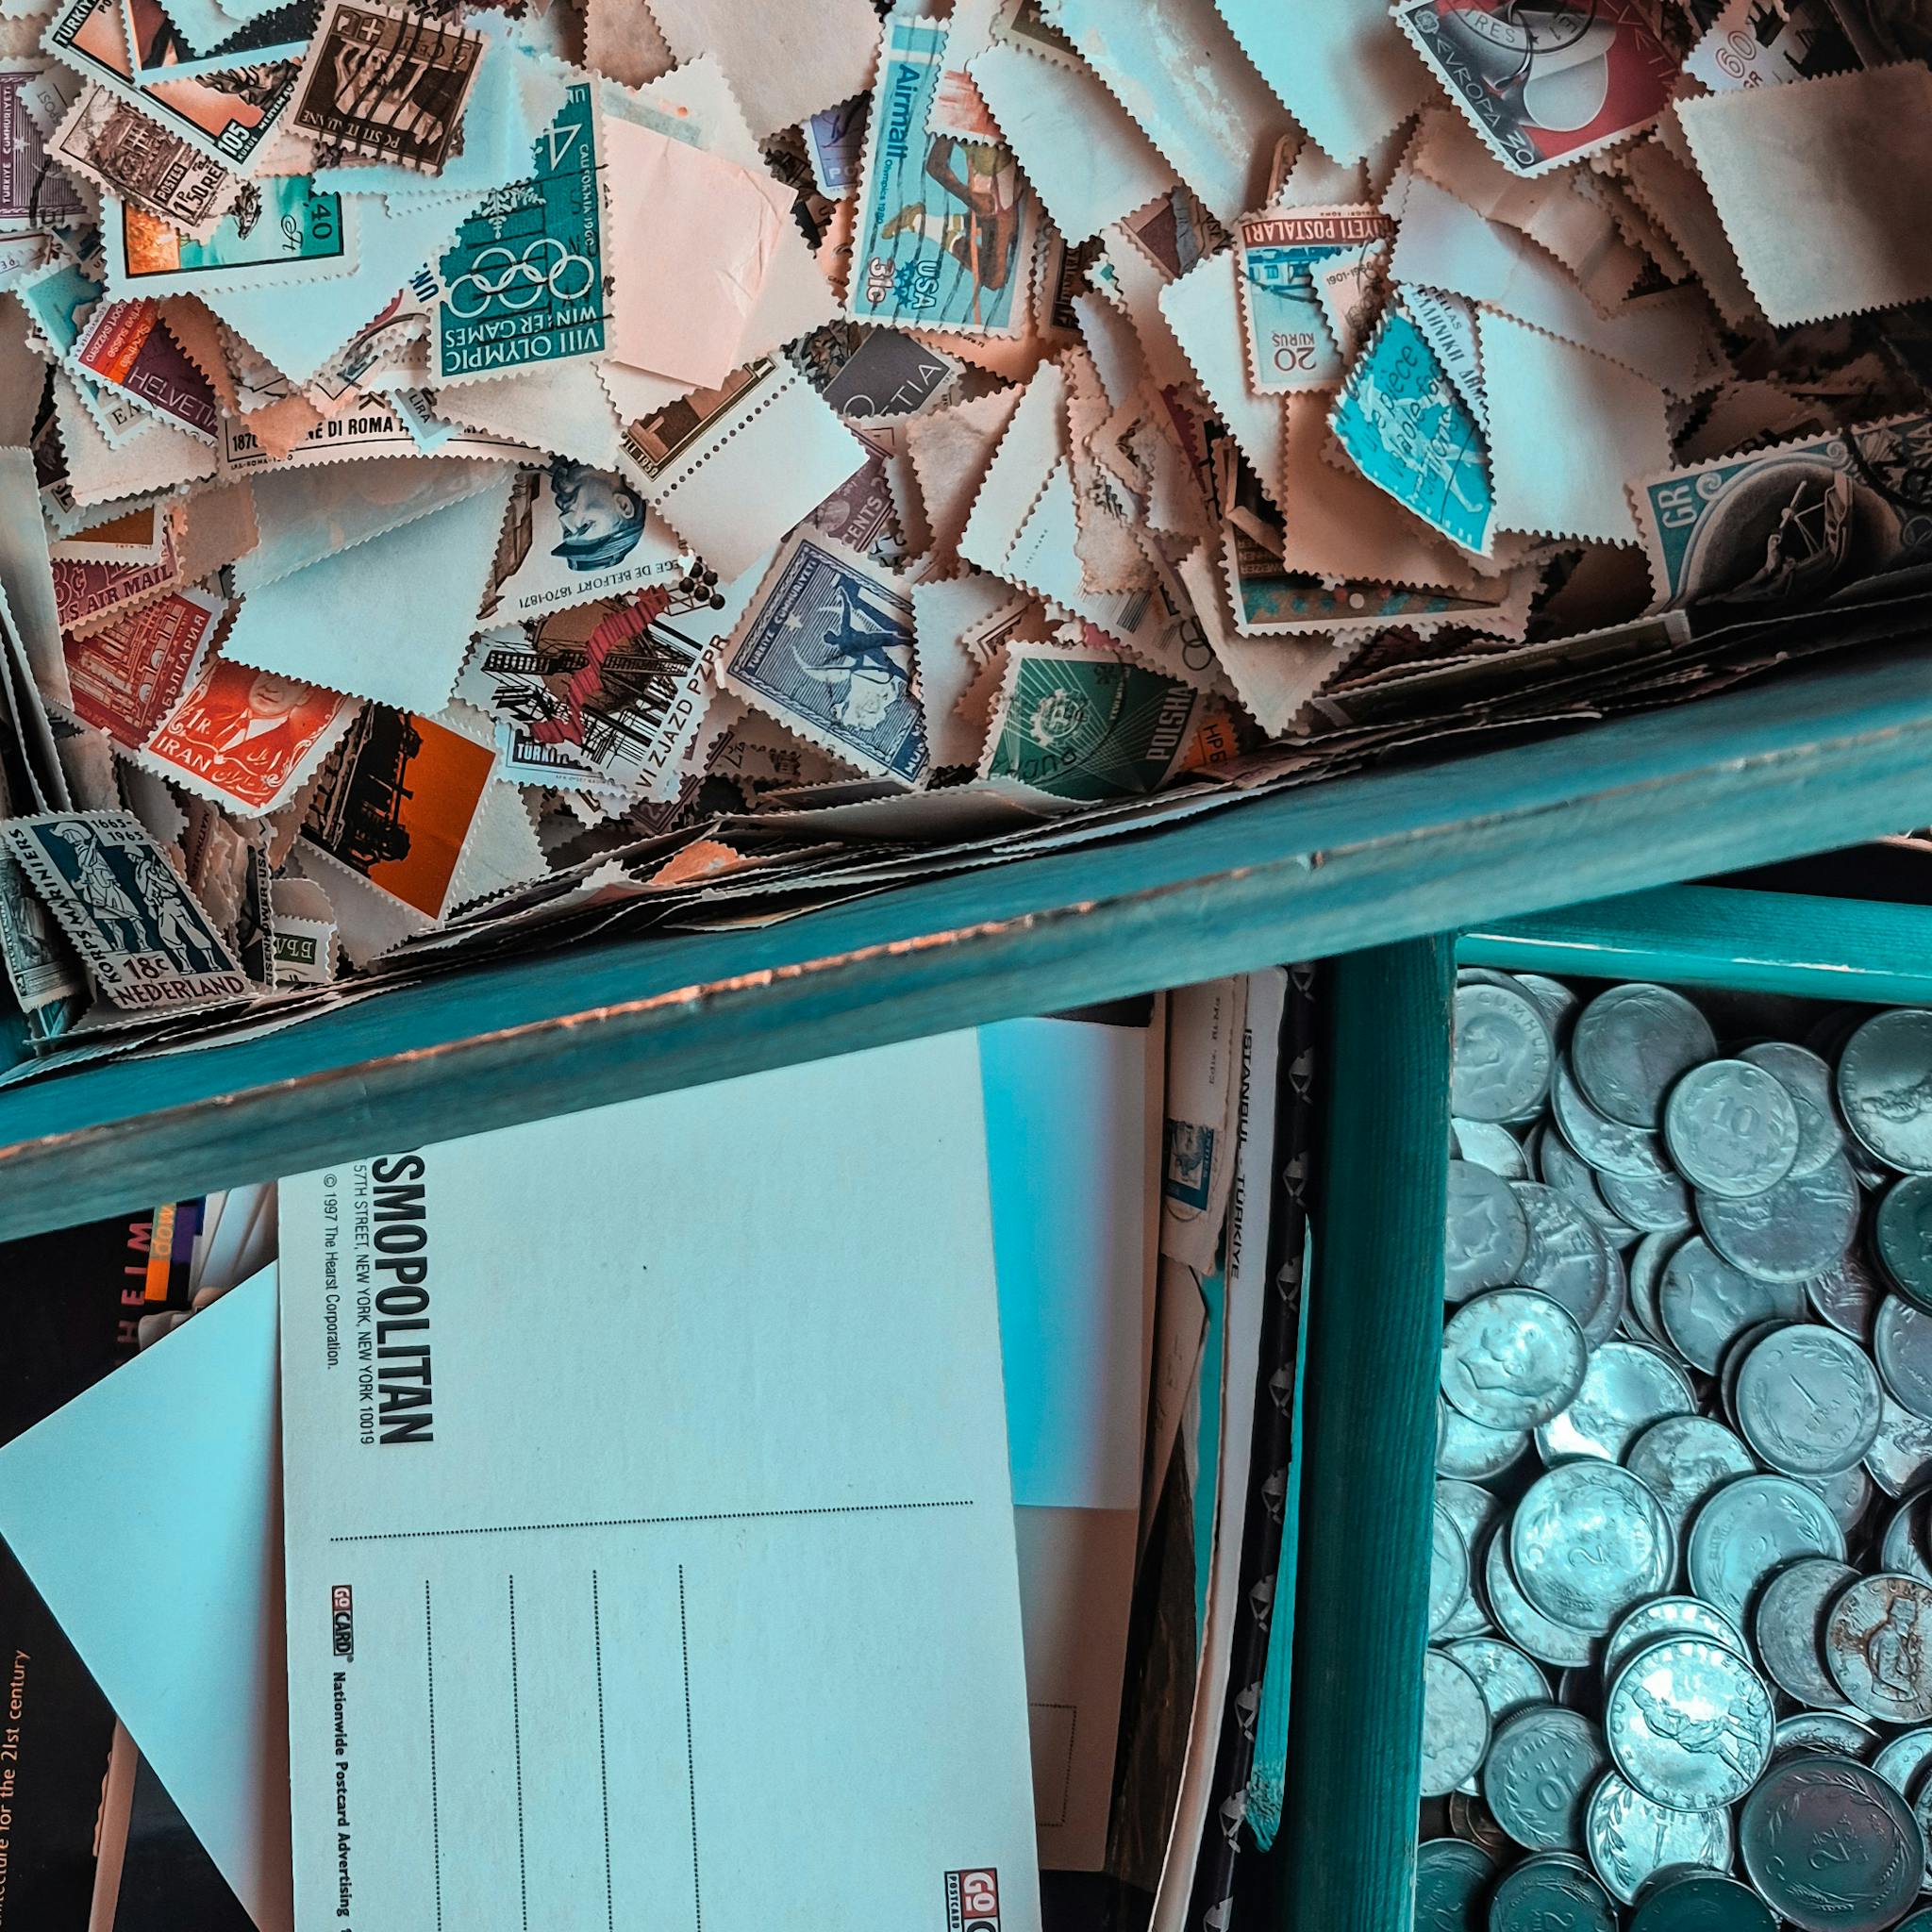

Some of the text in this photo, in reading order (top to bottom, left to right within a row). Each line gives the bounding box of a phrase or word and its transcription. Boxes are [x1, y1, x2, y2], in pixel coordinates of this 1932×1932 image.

[55, 0, 95, 45] TÜRKİY
[1715, 30, 1757, 79] 60
[1437, 38, 1503, 125] EVROPA
[889, 64, 920, 158] Airmail
[218, 124, 250, 155] 105
[158, 165, 185, 200] POSTES
[578, 143, 593, 214] CALIFORNIA
[881, 159, 892, 198] Olympics
[1246, 221, 1335, 243] POSTALARI
[913, 260, 939, 309] USA
[86, 323, 114, 364] svizzero
[446, 320, 516, 347] GAMES
[446, 328, 599, 371] VIII OLYMPIC
[1272, 332, 1315, 347] KURUŞ
[1274, 347, 1317, 371] 20
[328, 419, 342, 437] DI
[348, 417, 391, 435] ROMA
[88, 587, 122, 615] AIR
[123, 568, 174, 597] MAIL
[519, 558, 683, 609] EGE DE BELFORT 1870-1871
[163, 613, 207, 706] БЪЛГАРИЯ
[636, 634, 730, 789] VI ZJAZD PZPR
[156, 736, 211, 772] IRAN
[108, 831, 144, 846] 1965
[14, 828, 122, 982] KORPS MARINIERS
[117, 976, 245, 1006] NEDERLAND
[1715, 1095, 1759, 1138] 10
[324, 1193, 339, 1222] 1997
[325, 1225, 339, 1248] The
[117, 1223, 152, 1343] HEIM
[325, 1253, 340, 1291] Hearst
[354, 1164, 375, 1445] 57TH STREET, NEW YORK, NEW YORK 10019
[372, 1155, 434, 1445] SMOPOLITAN
[325, 1293, 341, 1370] Corporation.
[9, 1650, 31, 1720] century
[1, 1727, 20, 1761] 21st
[1, 1767, 16, 1798] the
[333, 1671, 354, 1917] Nationwide Postcard Advertising
[948, 1875, 960, 1929] POSTCARD
